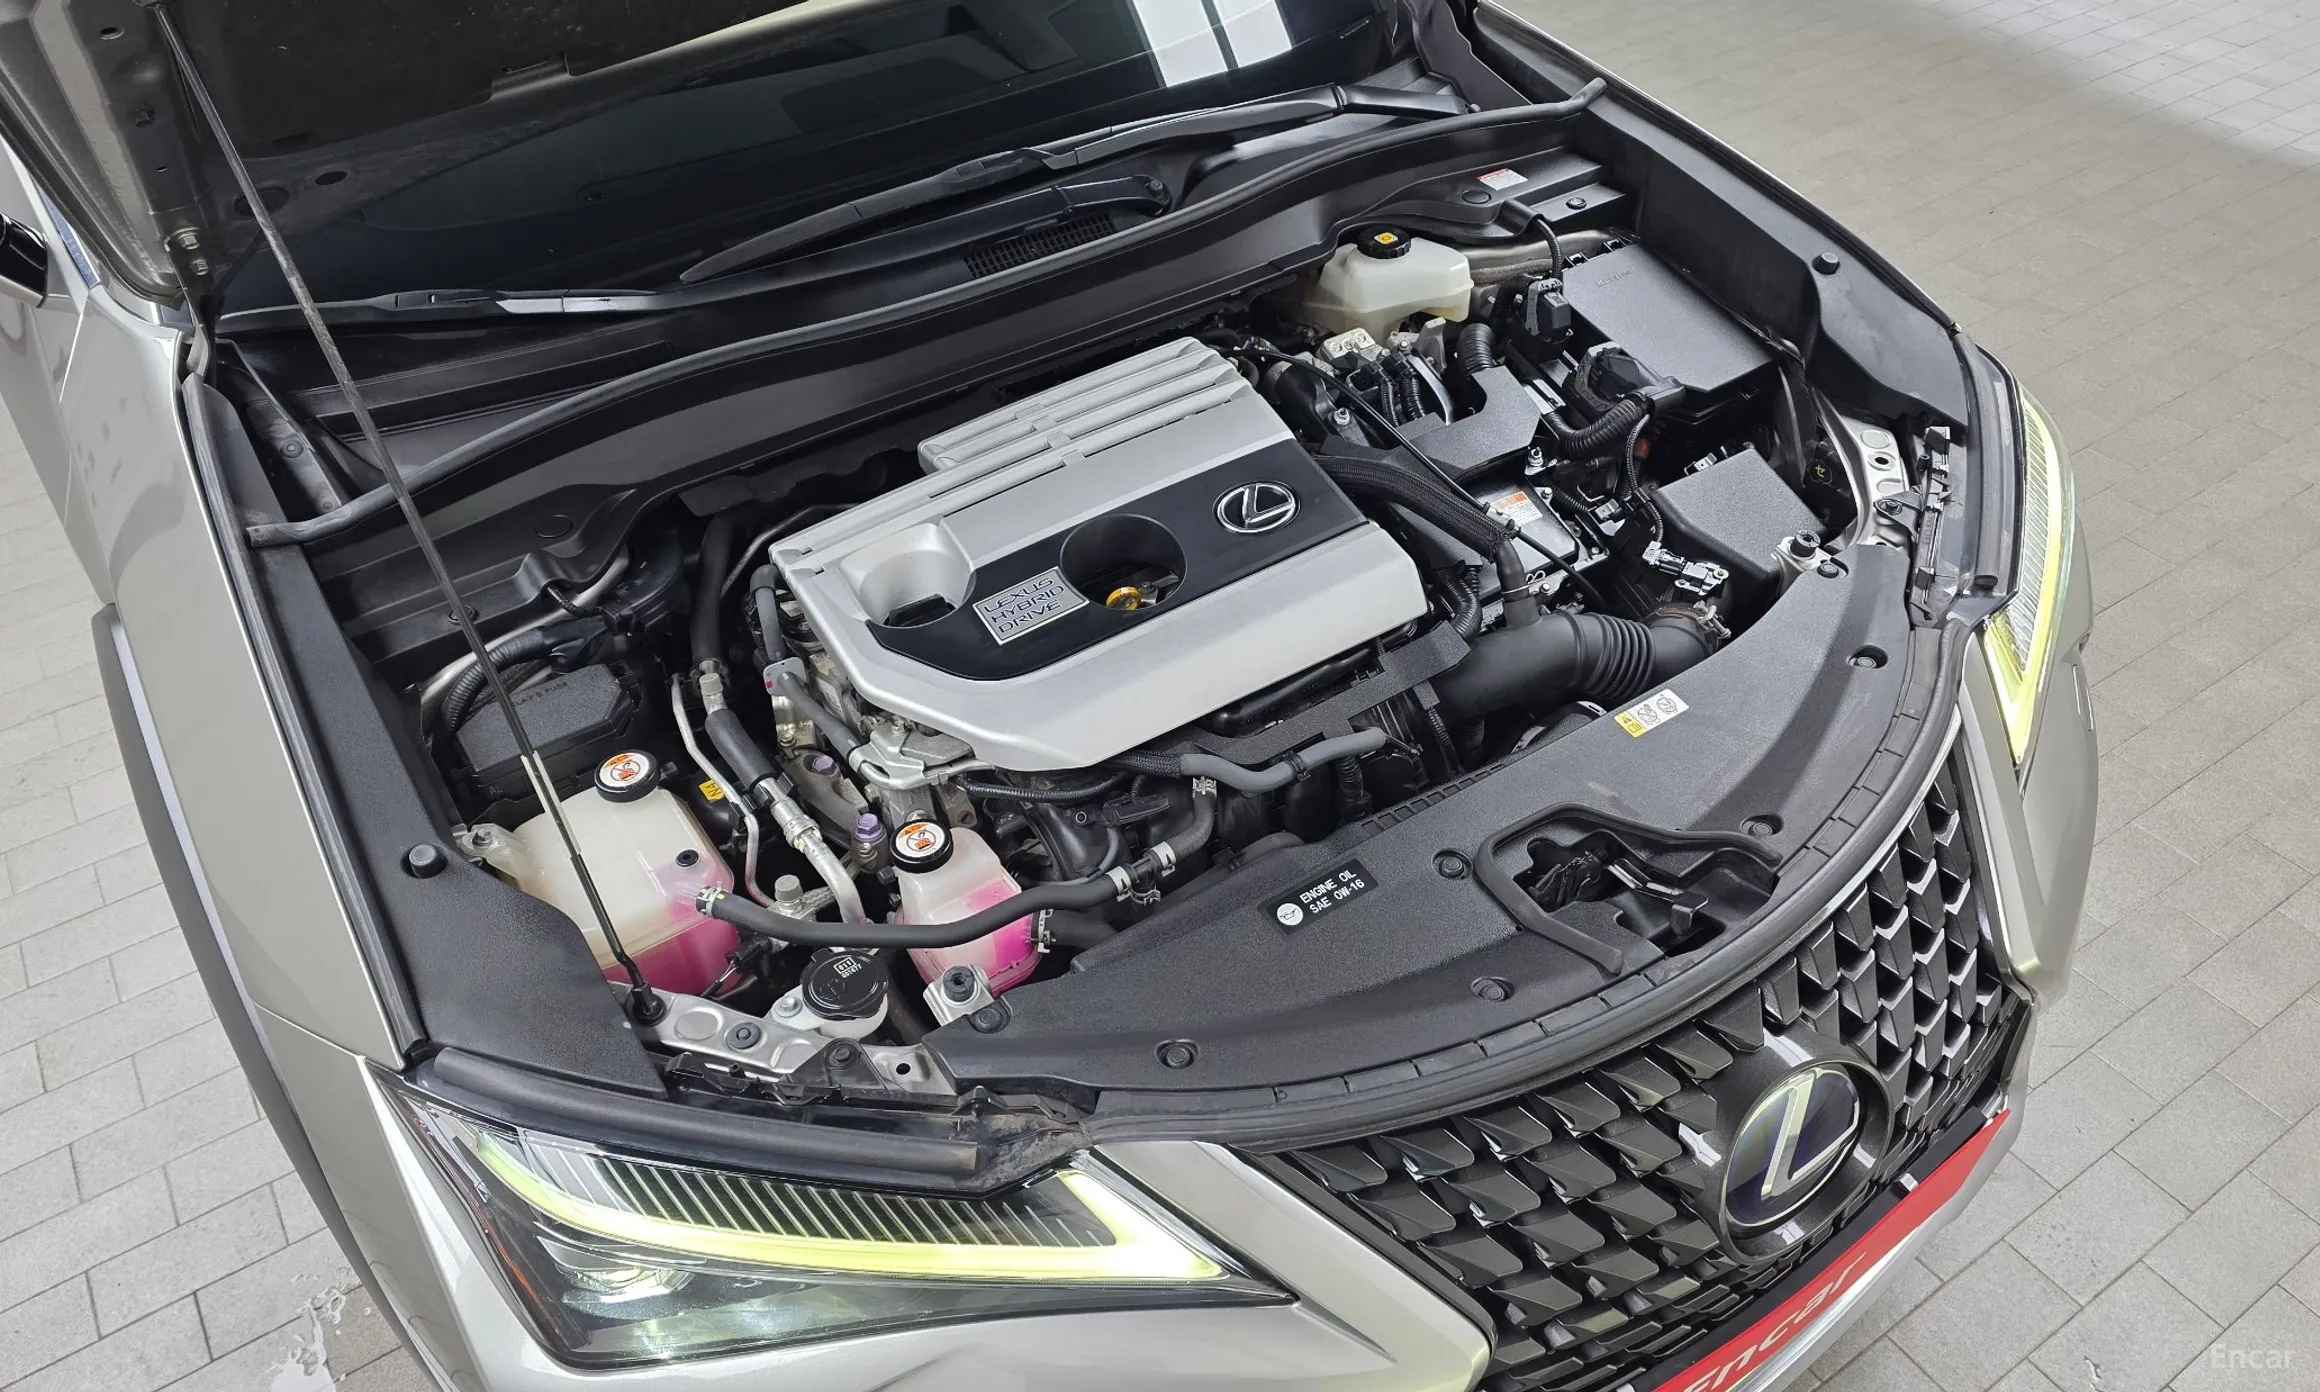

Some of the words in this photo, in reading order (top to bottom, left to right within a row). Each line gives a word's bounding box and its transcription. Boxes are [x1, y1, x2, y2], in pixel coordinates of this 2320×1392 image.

[984, 577, 1053, 612] LEXUS
[991, 586, 1064, 623] HYBRID
[998, 600, 1061, 633] DRIVE
[1300, 879, 1337, 903] ENGINE
[1338, 870, 1357, 882] OIL
[1309, 897, 1332, 913] SAE
[1333, 879, 1365, 900] 0W-16
